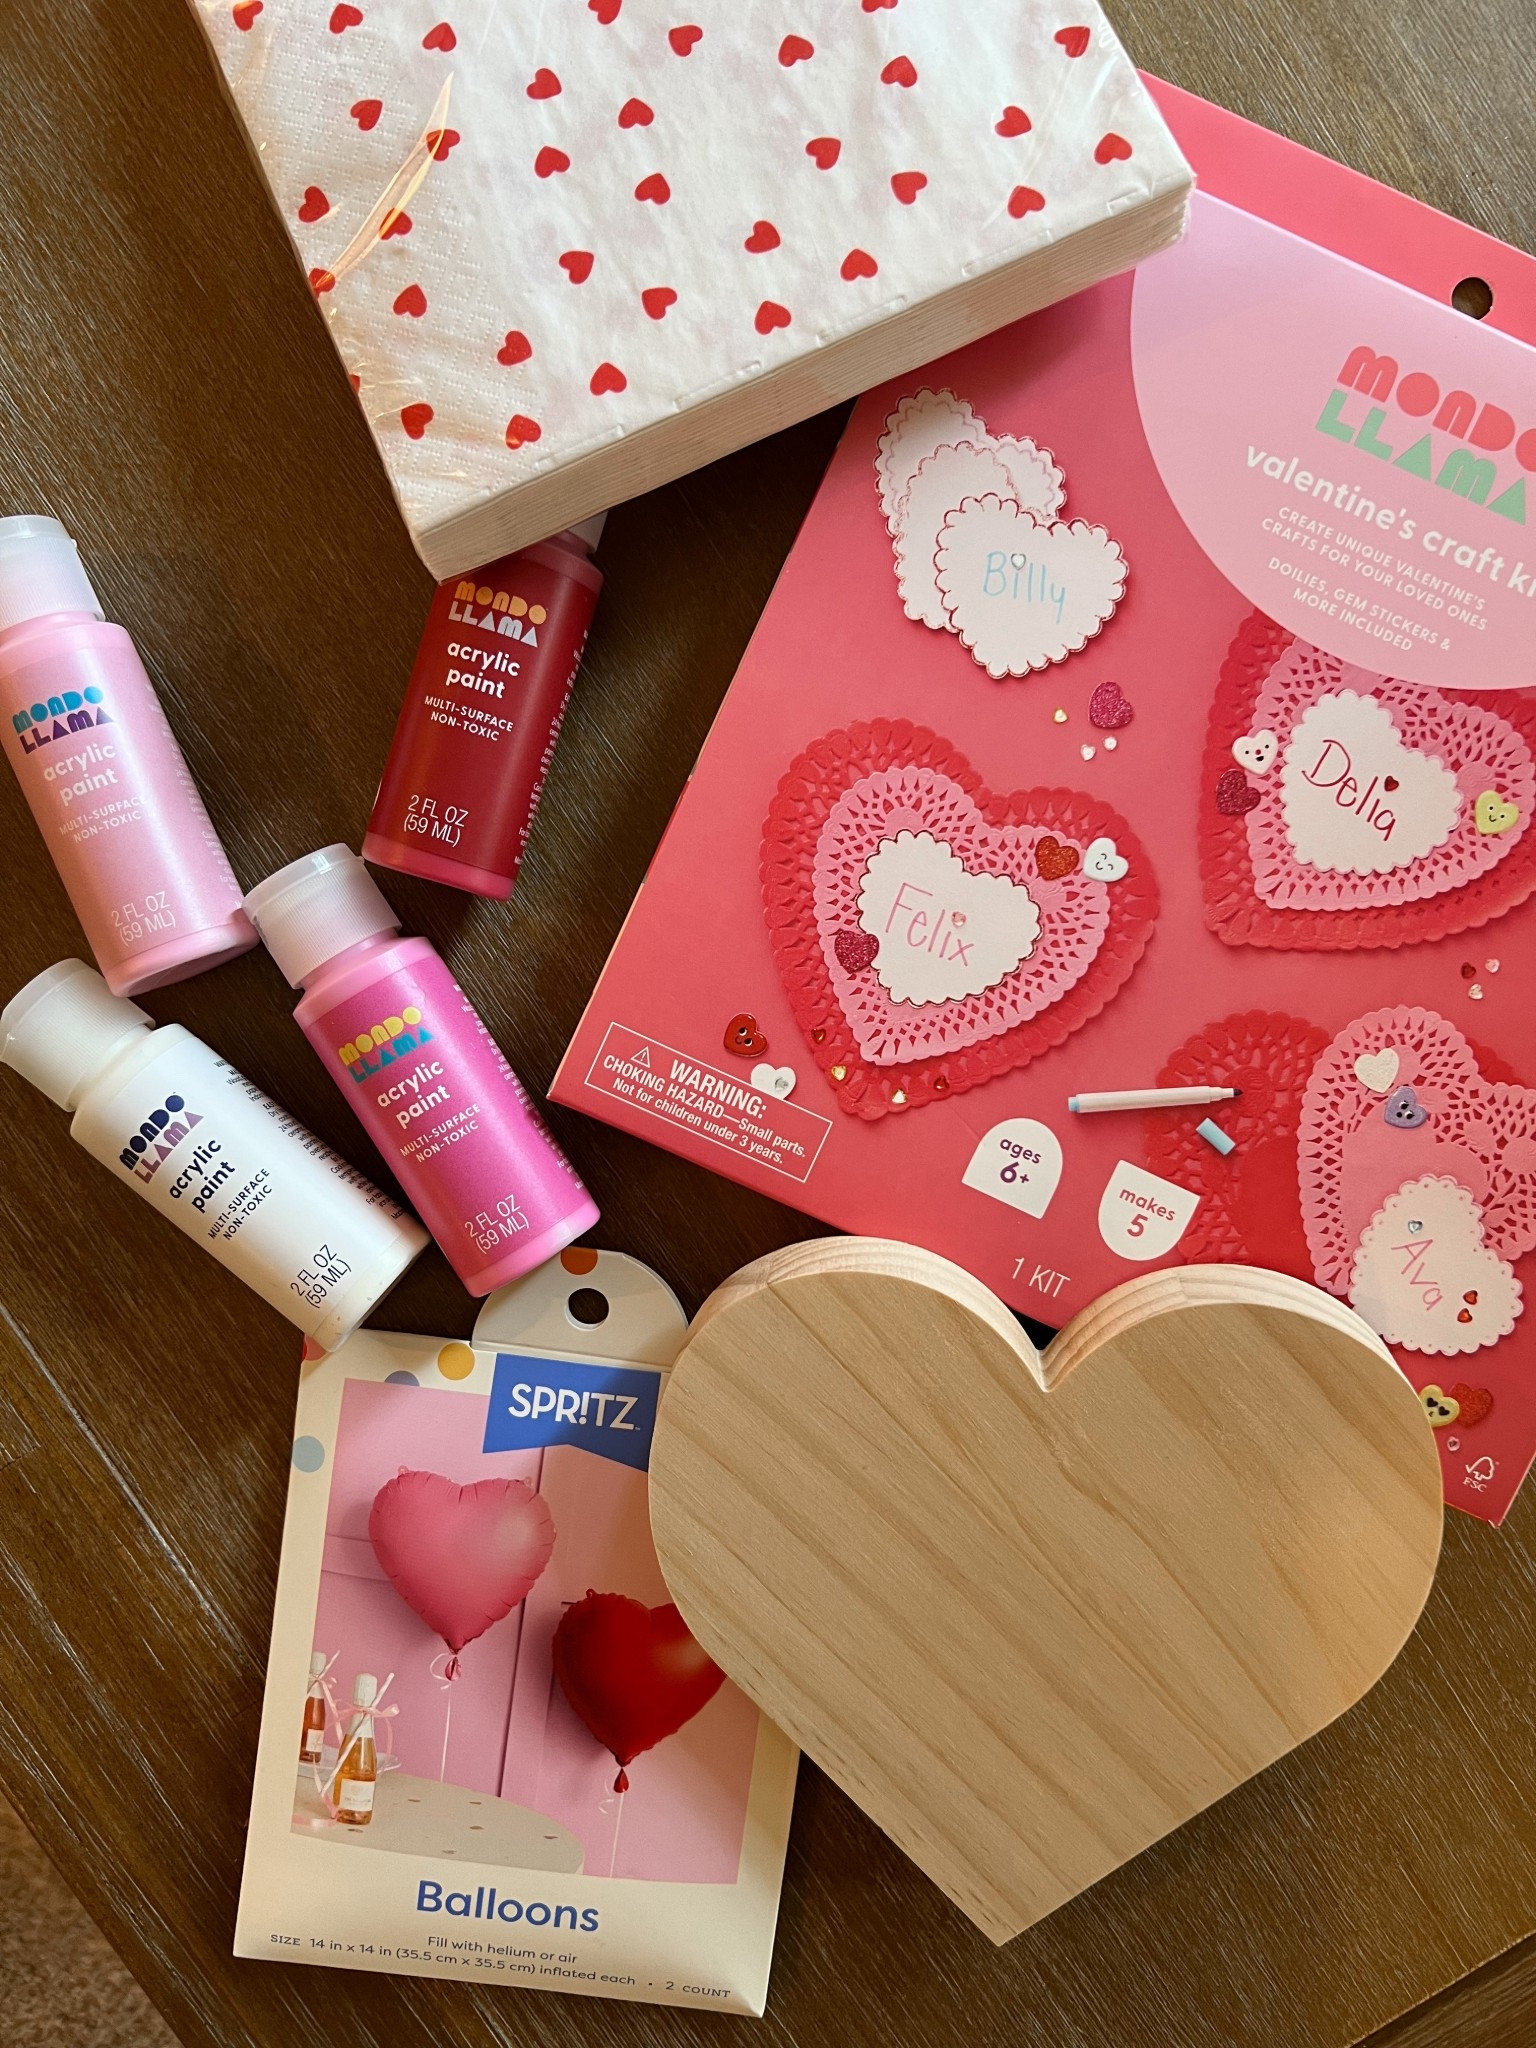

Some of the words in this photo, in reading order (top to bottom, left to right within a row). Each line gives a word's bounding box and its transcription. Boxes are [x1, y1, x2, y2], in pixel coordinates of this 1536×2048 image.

[1315, 389, 1527, 526] LLAMA
[1247, 445, 1417, 540] valentine's
[1422, 531, 1504, 582] craft
[1262, 518, 1317, 551] CRAFTS
[1319, 544, 1350, 567] FOR
[1353, 560, 1394, 588] YOUR
[1395, 583, 1444, 611] LOVED
[1447, 605, 1488, 631] ONES
[1278, 507, 1334, 540] CREATE
[1335, 532, 1393, 568] UNIQUE
[1396, 559, 1486, 611] VALENTINE'S
[454, 580, 547, 625] MONDO
[982, 551, 1065, 624] Billy
[1268, 557, 1329, 596] DOILIES,
[1334, 588, 1369, 612] GEM
[1369, 604, 1444, 645] STICKERS
[1440, 638, 1451, 651] &
[448, 600, 538, 648] LLAMA
[1292, 586, 1336, 617] MORE
[1339, 610, 1413, 651] INCLUDED
[447, 642, 520, 676] acrylic
[445, 668, 506, 699] paint
[12, 685, 104, 735] MONDO
[19, 706, 116, 755] LLAMA
[424, 695, 514, 732] MULTI-SURFACE
[430, 711, 500, 742] NON-TOXIC
[44, 743, 117, 782] acrylic
[59, 768, 118, 807] paint
[408, 794, 420, 811] 2
[421, 798, 439, 819] FL
[445, 806, 469, 827] OZ
[1302, 739, 1397, 841] Delia
[59, 795, 148, 836] MULTI-SURFACE
[73, 810, 142, 844] NON-TOXIC
[404, 813, 428, 834] (59
[431, 821, 460, 848] ML)
[111, 910, 123, 927] 2
[122, 902, 144, 922] FL
[145, 891, 171, 913] OZ
[119, 921, 143, 947] (59
[144, 909, 176, 934] ML)
[885, 882, 975, 967] Felix
[338, 1006, 422, 1067] MONDO
[348, 1026, 435, 1084] LLAMA
[377, 1061, 444, 1107] acrylic
[396, 1084, 451, 1130] paint
[603, 1054, 666, 1093] CHOKING
[773, 1135, 807, 1158] parts.
[669, 1059, 767, 1120] WARNING:
[119, 1095, 185, 1171] MONDO
[400, 1103, 481, 1157] MULTI-SURFACE
[416, 1120, 479, 1163] NON-TOXIC
[612, 1077, 636, 1095] Not
[636, 1087, 654, 1104] for
[654, 1094, 702, 1127] children
[703, 1119, 739, 1143] under
[739, 1134, 748, 1147] 3
[748, 1141, 783, 1165] years.
[134, 1111, 205, 1184] LLAMA
[169, 1140, 222, 1199] acrylic
[999, 1138, 1042, 1164] ages
[191, 1161, 236, 1214] paint
[999, 1161, 1030, 1184] 6+
[207, 1168, 270, 1240] MULTI-SURFACE
[223, 1184, 273, 1240] NON-TOXIC
[464, 1221, 478, 1238] 2
[475, 1211, 498, 1230] FL
[497, 1194, 520, 1217] OZ
[1119, 1188, 1176, 1222] makes
[1126, 1213, 1149, 1237] 5
[313, 1244, 337, 1268] OZ
[475, 1229, 499, 1254] (59
[498, 1211, 529, 1238] ML)
[290, 1282, 305, 1296] 2
[297, 1268, 320, 1287] FL
[304, 1283, 327, 1309] (59
[321, 1258, 352, 1287] ML)
[1012, 1257, 1025, 1280] 1
[1028, 1264, 1072, 1298] KIT
[1391, 1239, 1443, 1311] Ava
[1463, 1476, 1487, 1493] FSC
[416, 1879, 599, 1932] Balloons
[270, 1934, 301, 1946] SIZE
[309, 1938, 326, 1949] 14
[329, 1940, 342, 1951] in
[346, 1944, 355, 1952] x
[359, 1944, 375, 1954] 14
[379, 1945, 392, 1957] in
[396, 1948, 432, 1962] (35.5
[435, 1954, 458, 1965] cm
[461, 1957, 471, 1966] x
[474, 1957, 506, 1970] 35.5
[509, 1963, 536, 1974] cm)
[539, 1965, 597, 1980] inflated
[600, 1974, 636, 1985] each
[665, 1981, 675, 1991] 2
[682, 1985, 732, 1998] COUNT
[427, 1936, 448, 1948] Fill
[452, 1939, 483, 1953] with
[487, 1944, 536, 1959] helium
[539, 1952, 555, 1961] or
[558, 1953, 578, 1964] air
